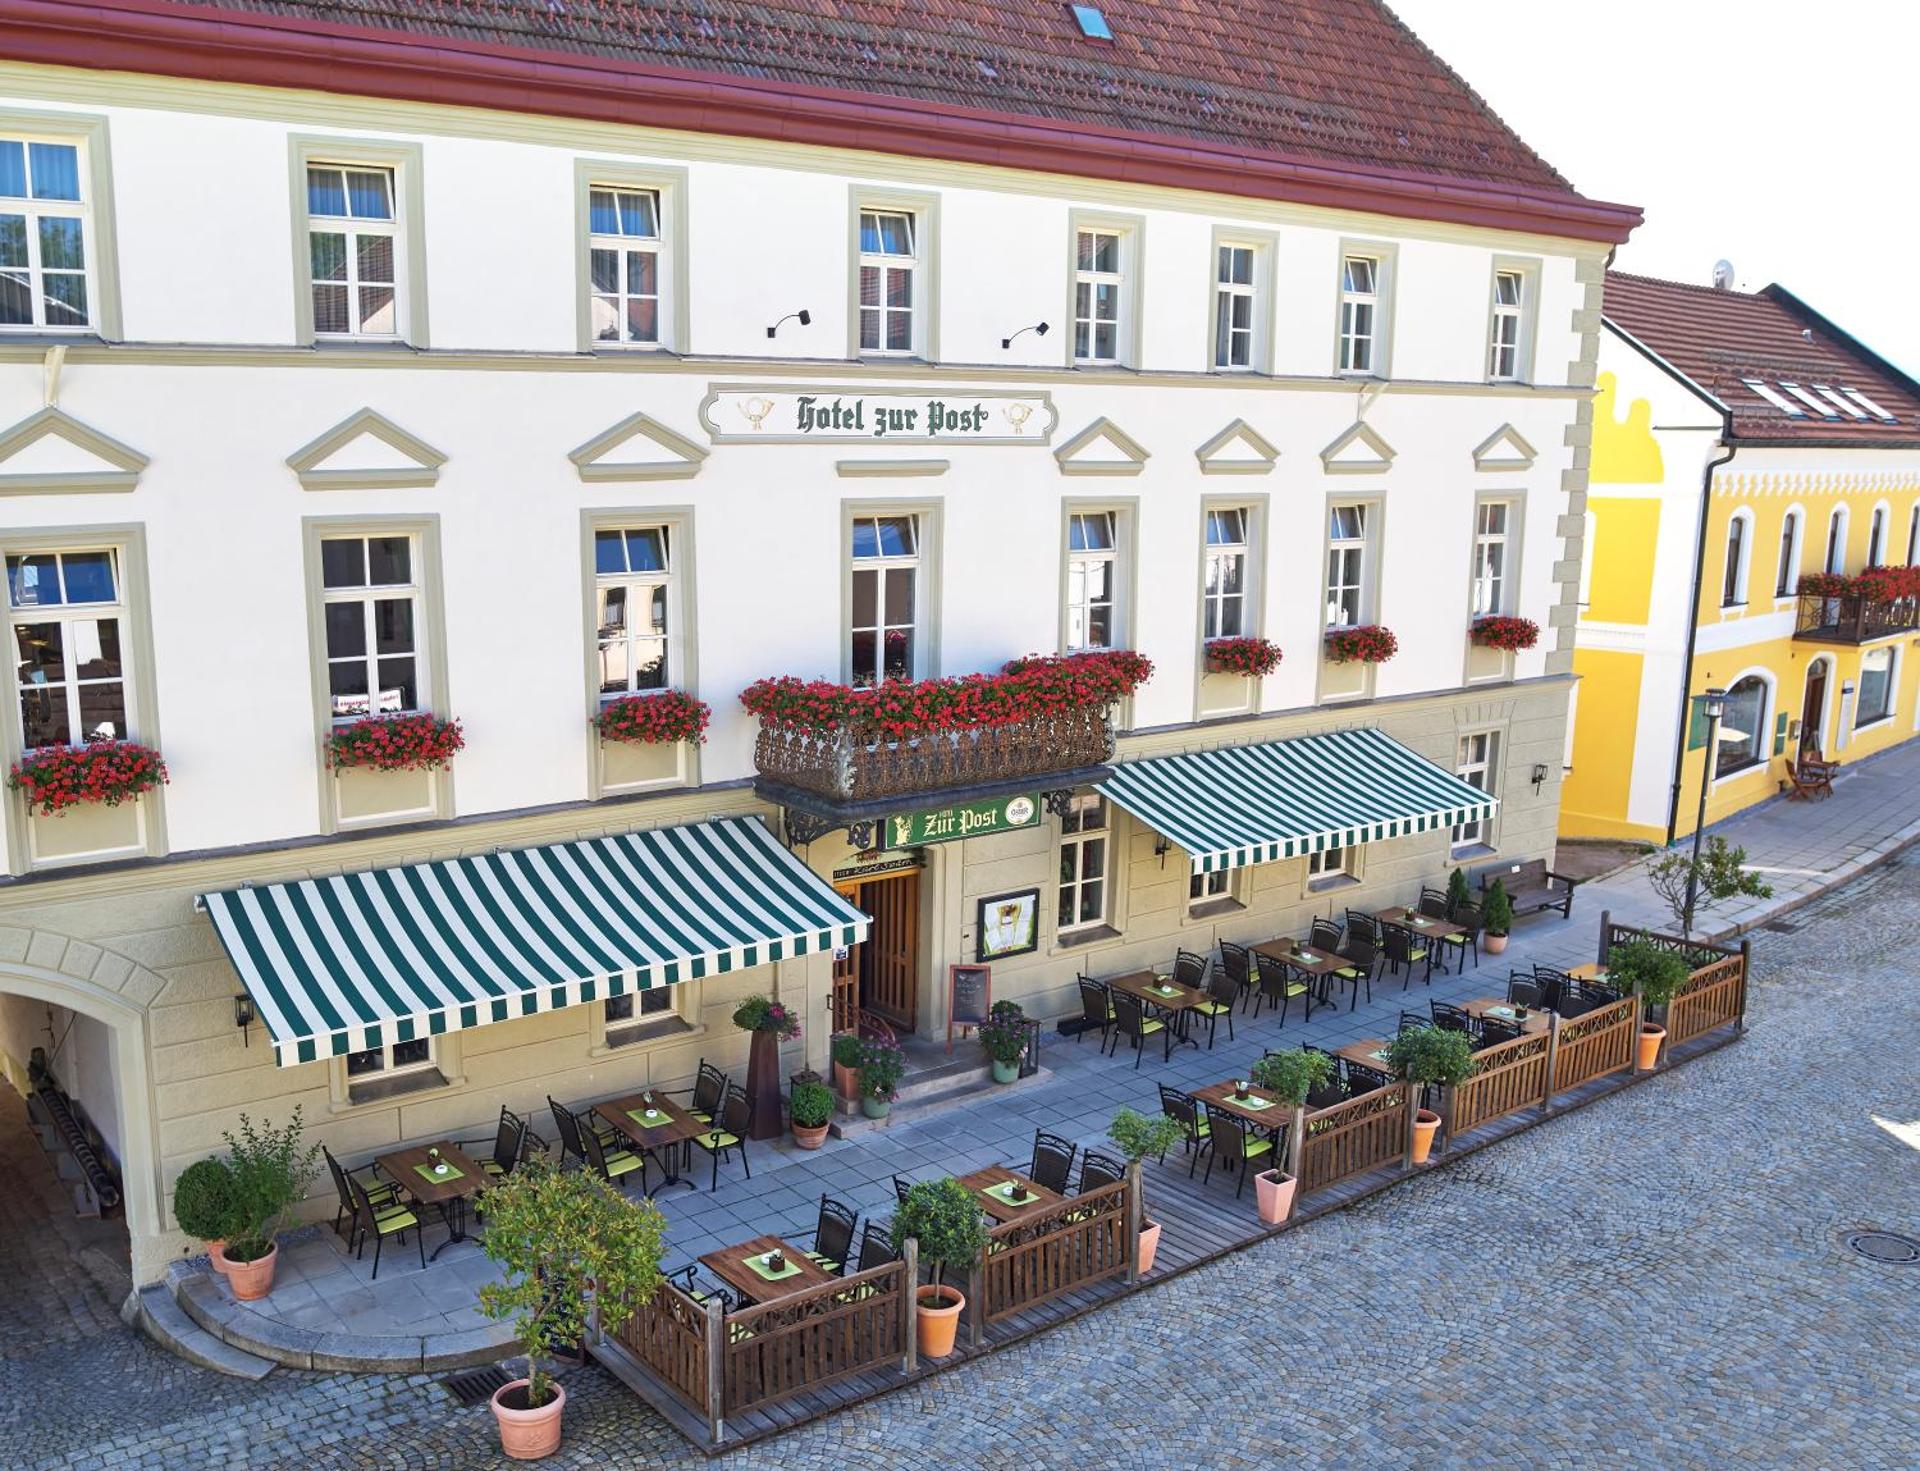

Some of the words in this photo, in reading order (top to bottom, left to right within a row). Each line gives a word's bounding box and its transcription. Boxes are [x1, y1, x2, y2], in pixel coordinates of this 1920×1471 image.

[797, 396, 864, 433] Hotel
[874, 407, 918, 436] zur
[927, 400, 989, 436] Post
[958, 808, 997, 834] Post
